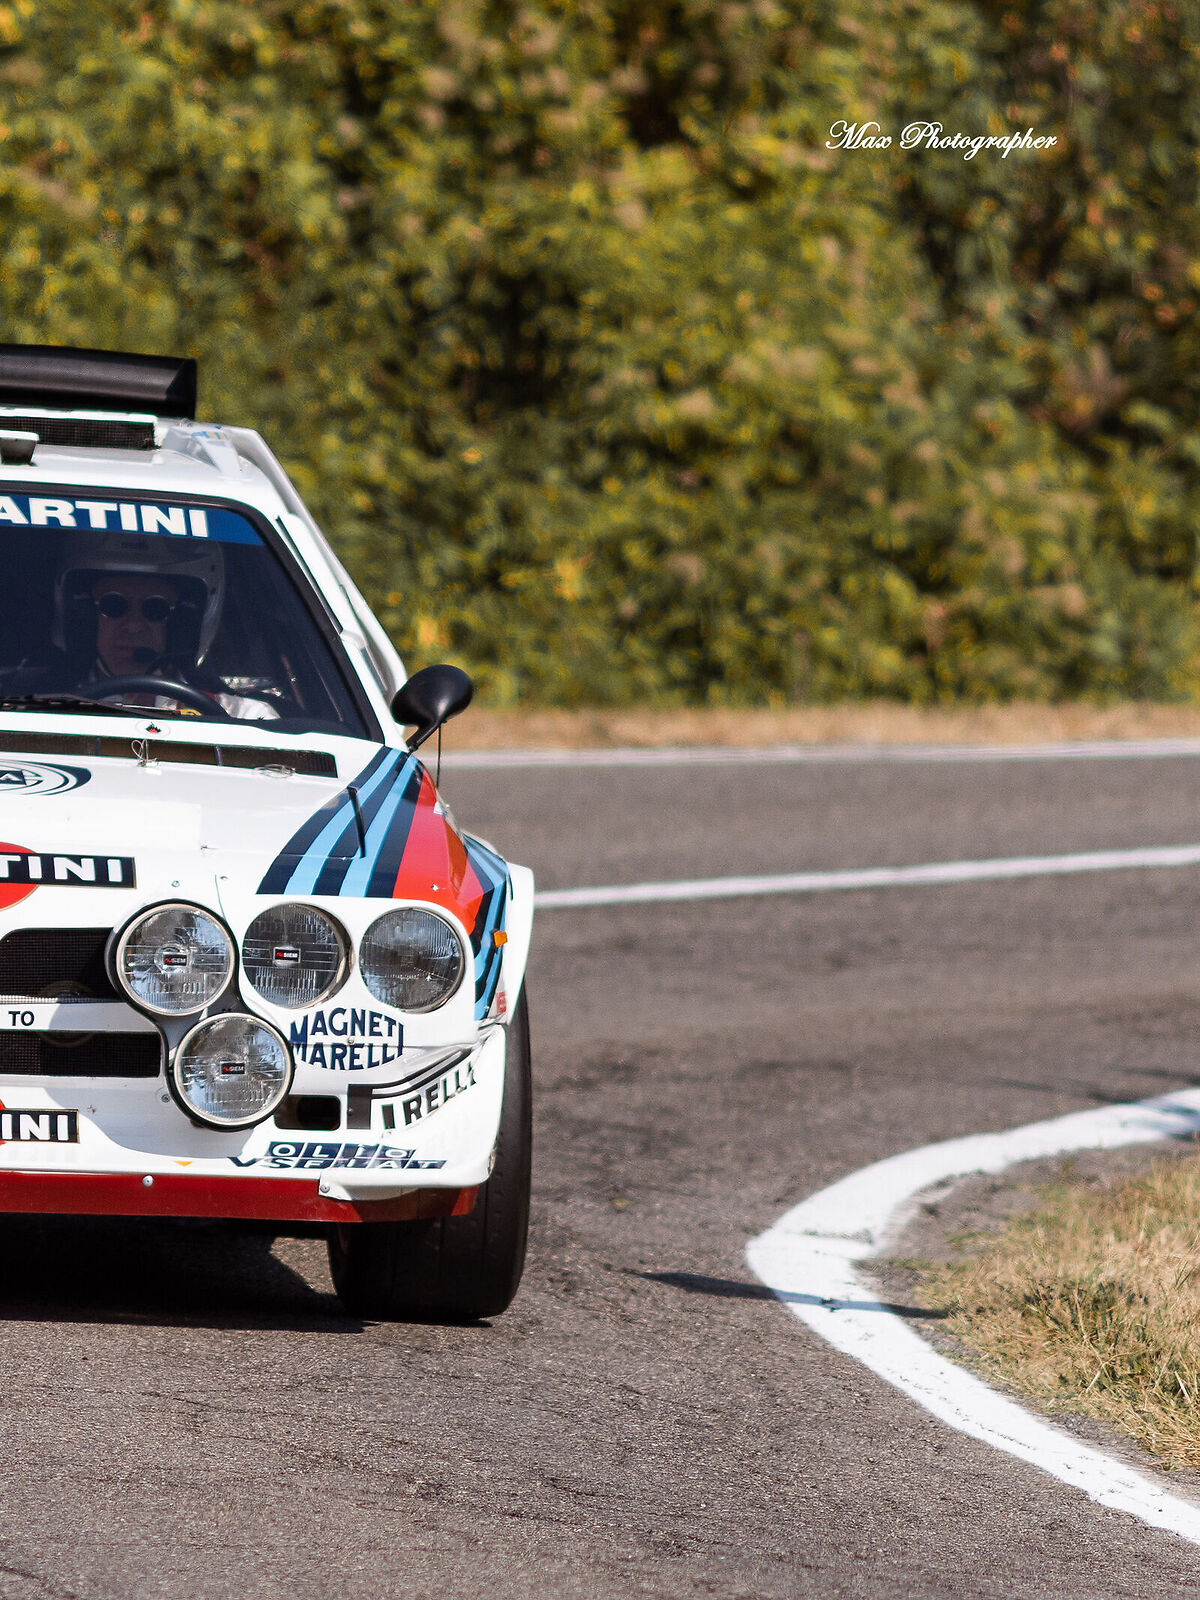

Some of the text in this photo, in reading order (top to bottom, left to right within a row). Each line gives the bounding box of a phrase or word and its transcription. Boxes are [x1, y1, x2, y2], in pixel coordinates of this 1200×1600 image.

[8, 1010, 35, 1026] TO
[290, 1007, 404, 1046] MAGNETI
[290, 1041, 404, 1071] MARELLI
[346, 1047, 477, 1130] PIRELLI
[272, 1143, 409, 1158] OLIO
